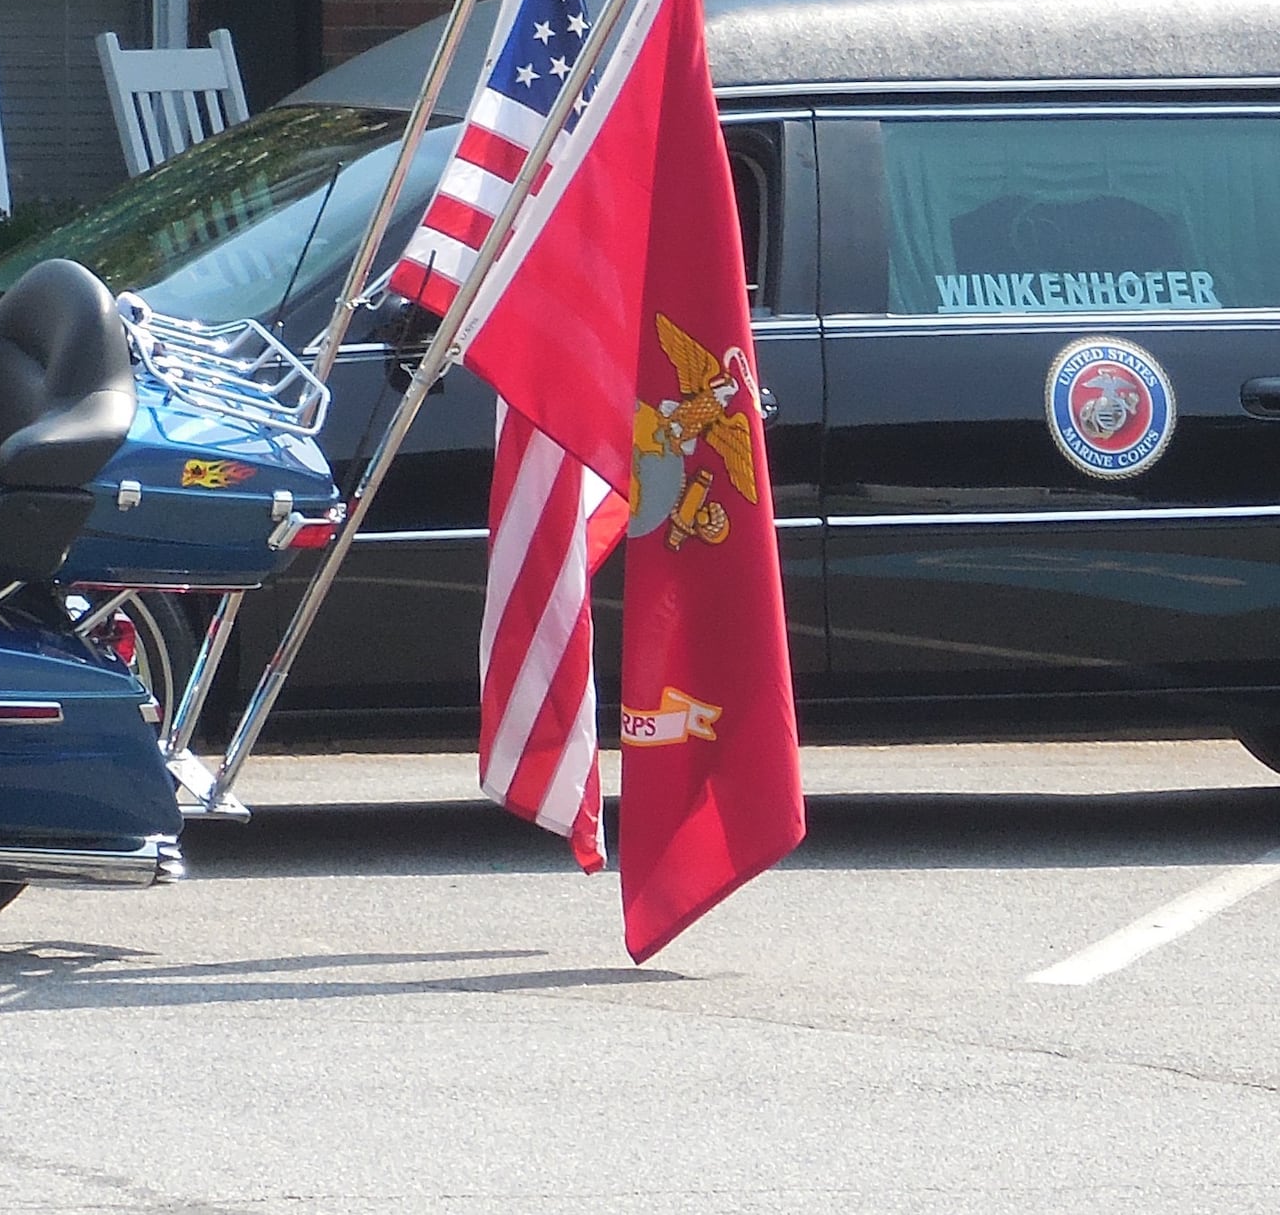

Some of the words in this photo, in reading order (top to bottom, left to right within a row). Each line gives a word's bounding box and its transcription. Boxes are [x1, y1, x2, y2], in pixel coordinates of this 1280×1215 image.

[934, 271, 1221, 310] WINKENHOFER
[1058, 348, 1104, 386] UNITED
[1107, 348, 1158, 388] STATES
[1062, 427, 1113, 468] MARINE
[1117, 429, 1160, 467] CORPS
